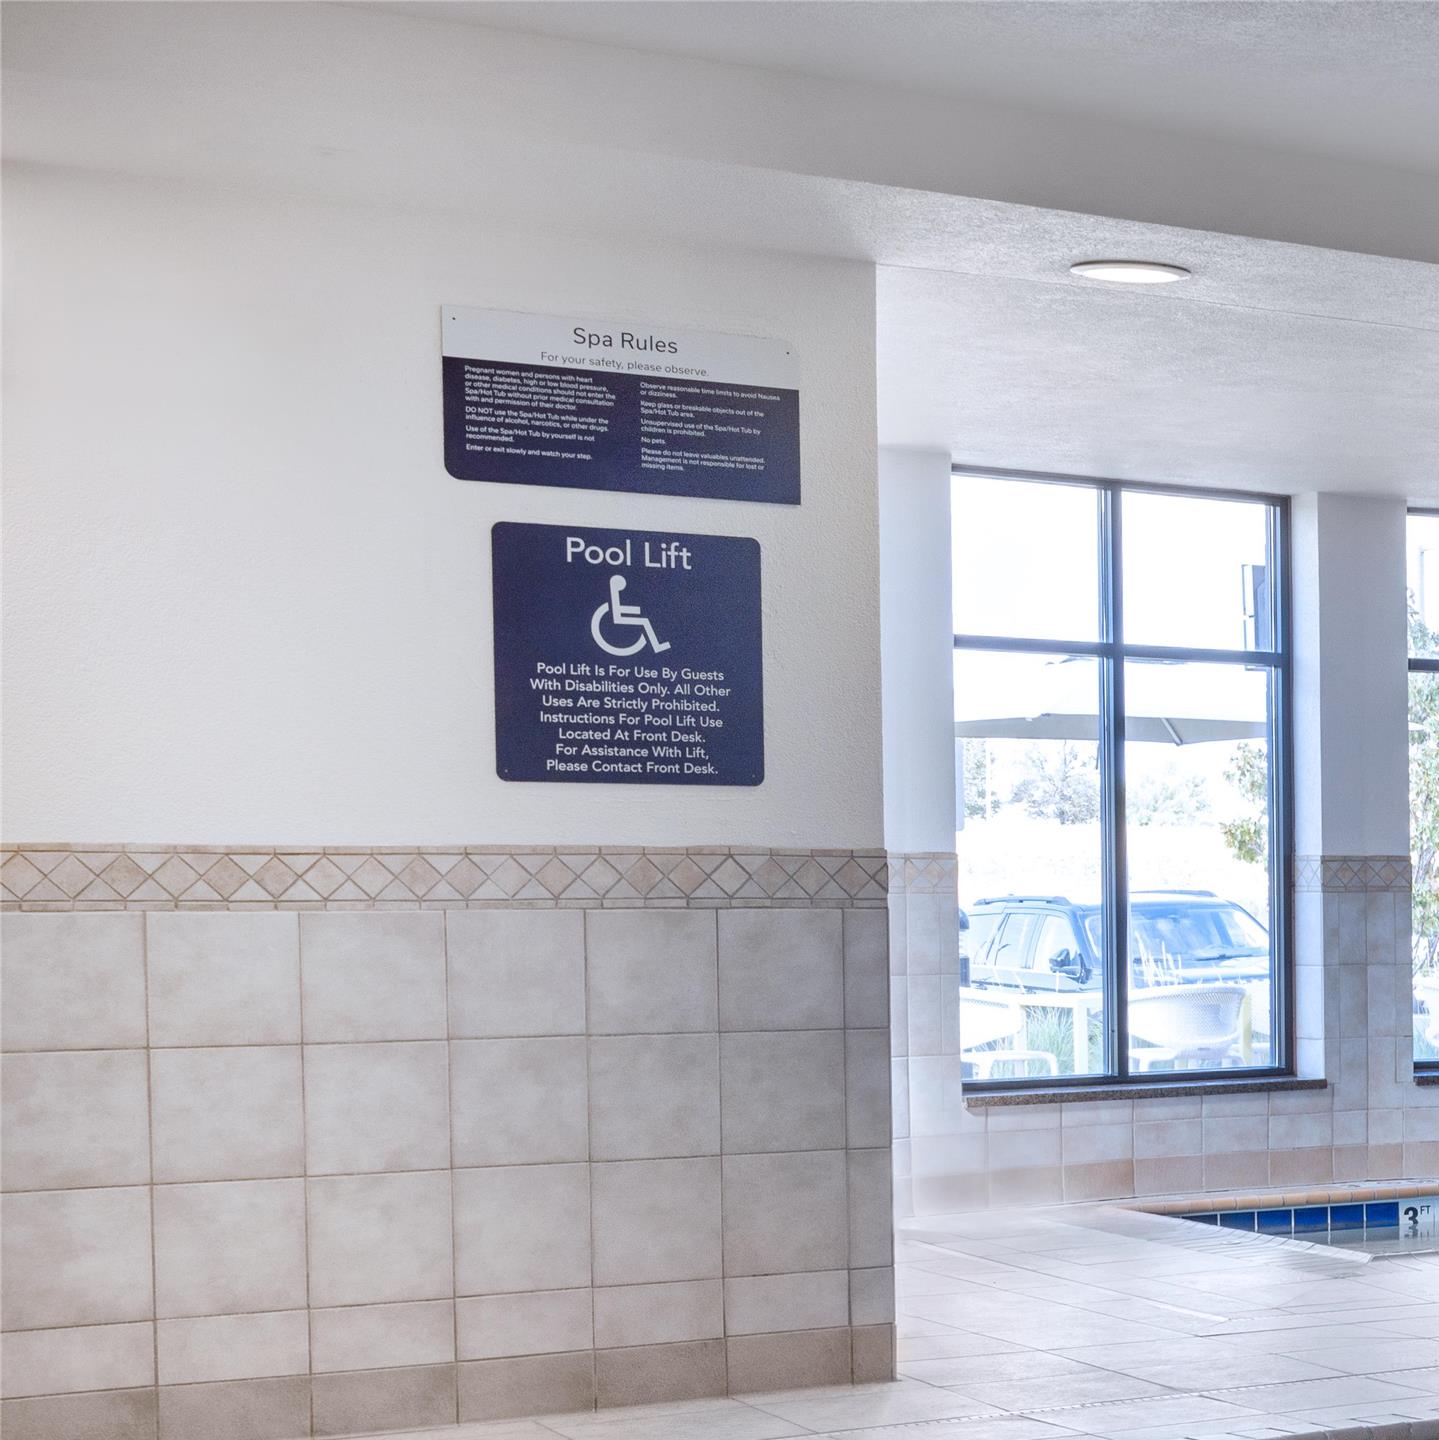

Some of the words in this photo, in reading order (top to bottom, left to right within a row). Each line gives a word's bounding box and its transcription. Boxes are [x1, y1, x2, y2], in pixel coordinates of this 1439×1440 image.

[573, 328, 612, 350] Spa
[621, 332, 678, 353] Rules
[541, 352, 558, 362] For
[561, 356, 585, 366] your
[588, 358, 623, 371] safety,
[627, 361, 662, 372] please
[664, 364, 710, 377] observe.
[566, 537, 631, 566] Pool
[644, 541, 693, 570] Lift
[537, 662, 566, 675] Pool
[570, 663, 591, 676] Lift
[594, 664, 605, 676] Is
[608, 664, 630, 677] For
[634, 665, 658, 678] Use
[661, 666, 677, 682] By
[680, 667, 724, 680] Guests
[530, 677, 561, 690] With
[564, 678, 634, 693] Disabilities
[637, 680, 670, 697] Only.
[673, 682, 690, 695] All
[693, 682, 731, 696] Other
[542, 694, 573, 707] Uses
[576, 695, 600, 708] Are
[603, 696, 648, 713] Strictly
[651, 697, 720, 712] Prohibited.
[540, 710, 615, 724] Instructions
[618, 712, 640, 725] For
[644, 713, 672, 726] Pool
[676, 714, 696, 726] Lift
[699, 714, 723, 727] Use
[559, 727, 610, 740] Located
[614, 728, 629, 741] At
[633, 729, 667, 742] Front
[671, 730, 706, 742] Desk.
[556, 742, 577, 755] For
[581, 743, 648, 757] Assistance
[651, 745, 681, 758] With
[685, 746, 709, 760] Lift,
[546, 759, 588, 771] Please
[591, 759, 642, 773] Contact
[646, 761, 680, 773] Front
[683, 761, 718, 774] Desk.
